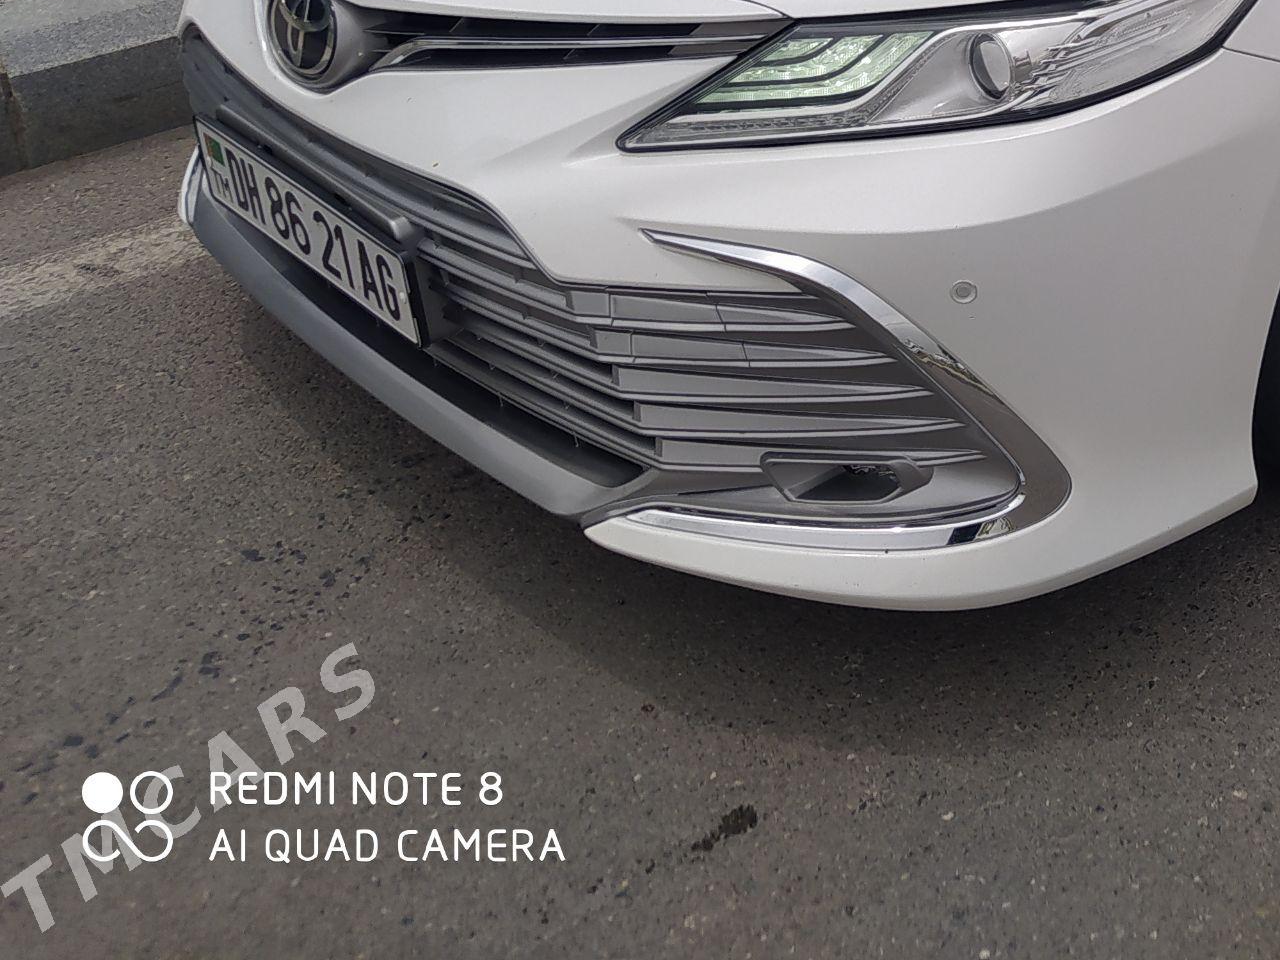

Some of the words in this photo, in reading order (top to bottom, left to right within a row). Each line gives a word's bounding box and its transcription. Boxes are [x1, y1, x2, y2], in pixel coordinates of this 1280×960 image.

[225, 146, 266, 226] DH
[264, 176, 311, 256] 86
[312, 210, 355, 290] 21
[357, 239, 401, 322] AG
